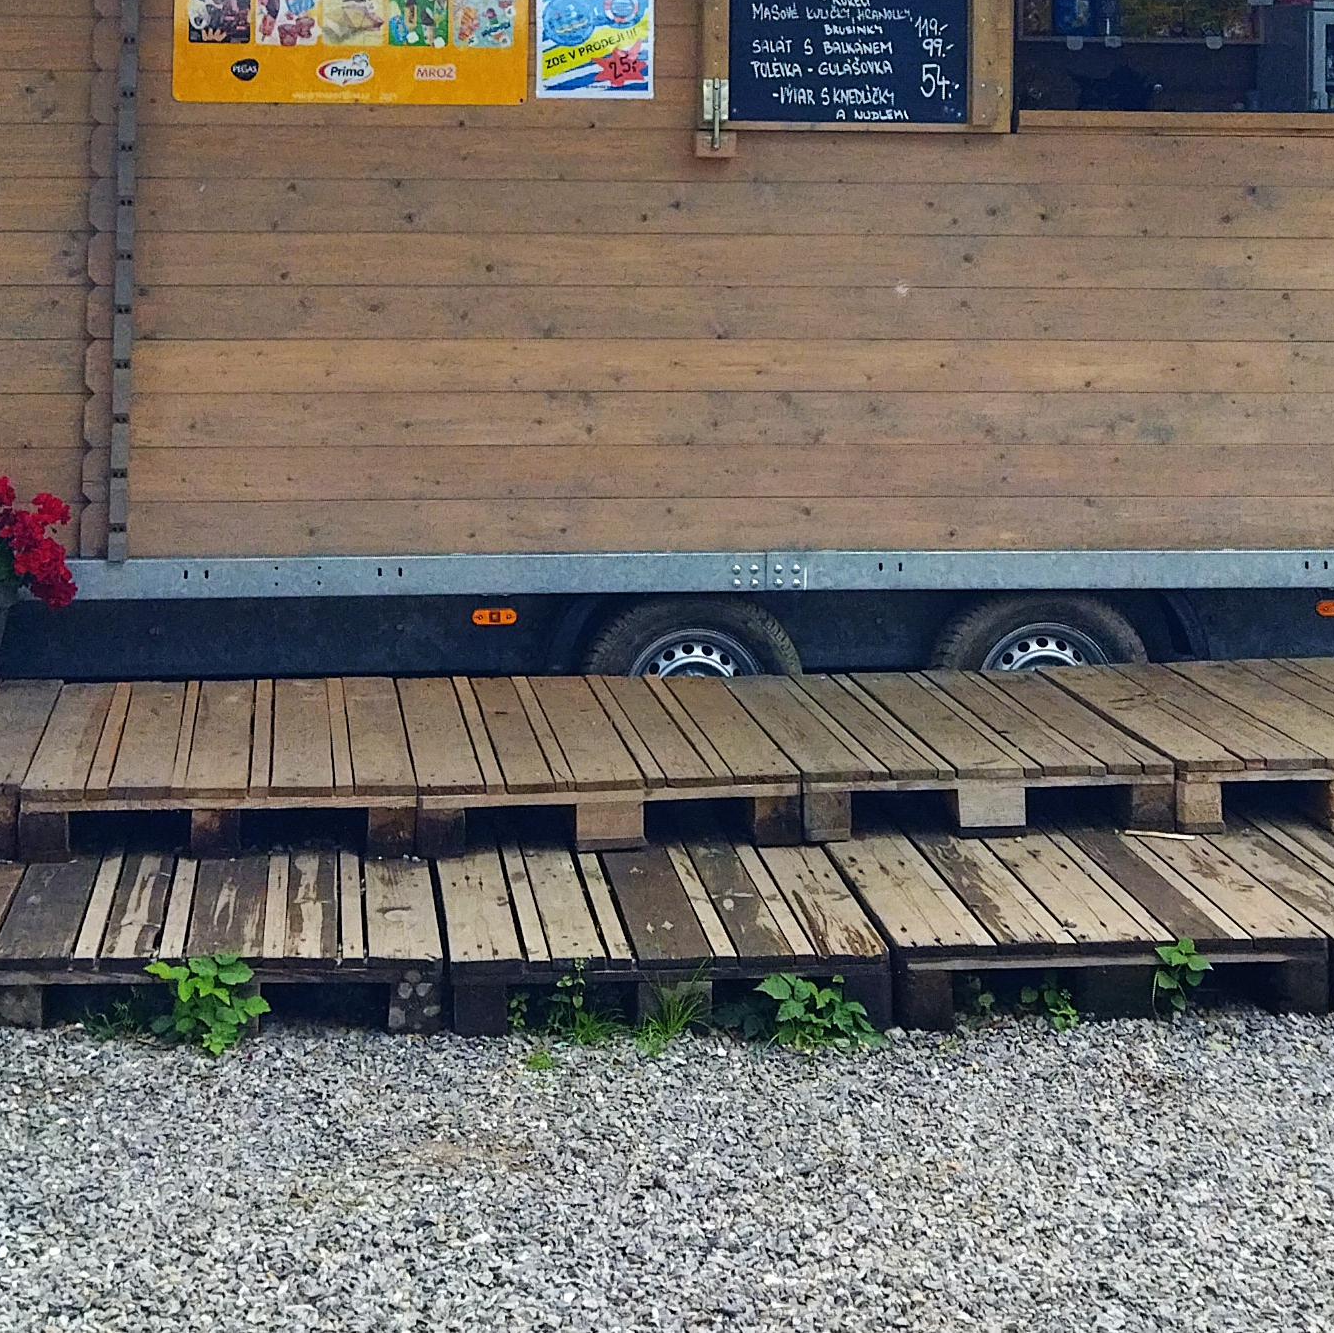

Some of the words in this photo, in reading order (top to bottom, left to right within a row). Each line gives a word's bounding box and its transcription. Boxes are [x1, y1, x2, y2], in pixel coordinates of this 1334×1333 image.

[752, 3, 799, 22] MASOVÉ
[752, 35, 793, 54] SALÁT
[804, 38, 814, 56] S
[823, 39, 893, 56] BALKÁNEM
[545, 54, 567, 70] ZDE
[568, 49, 576, 60] V
[818, 57, 893, 77] GULÁŠOVKA
[330, 65, 365, 78] Prima
[836, 109, 846, 120] A
[854, 109, 909, 120] NUDLEMI
